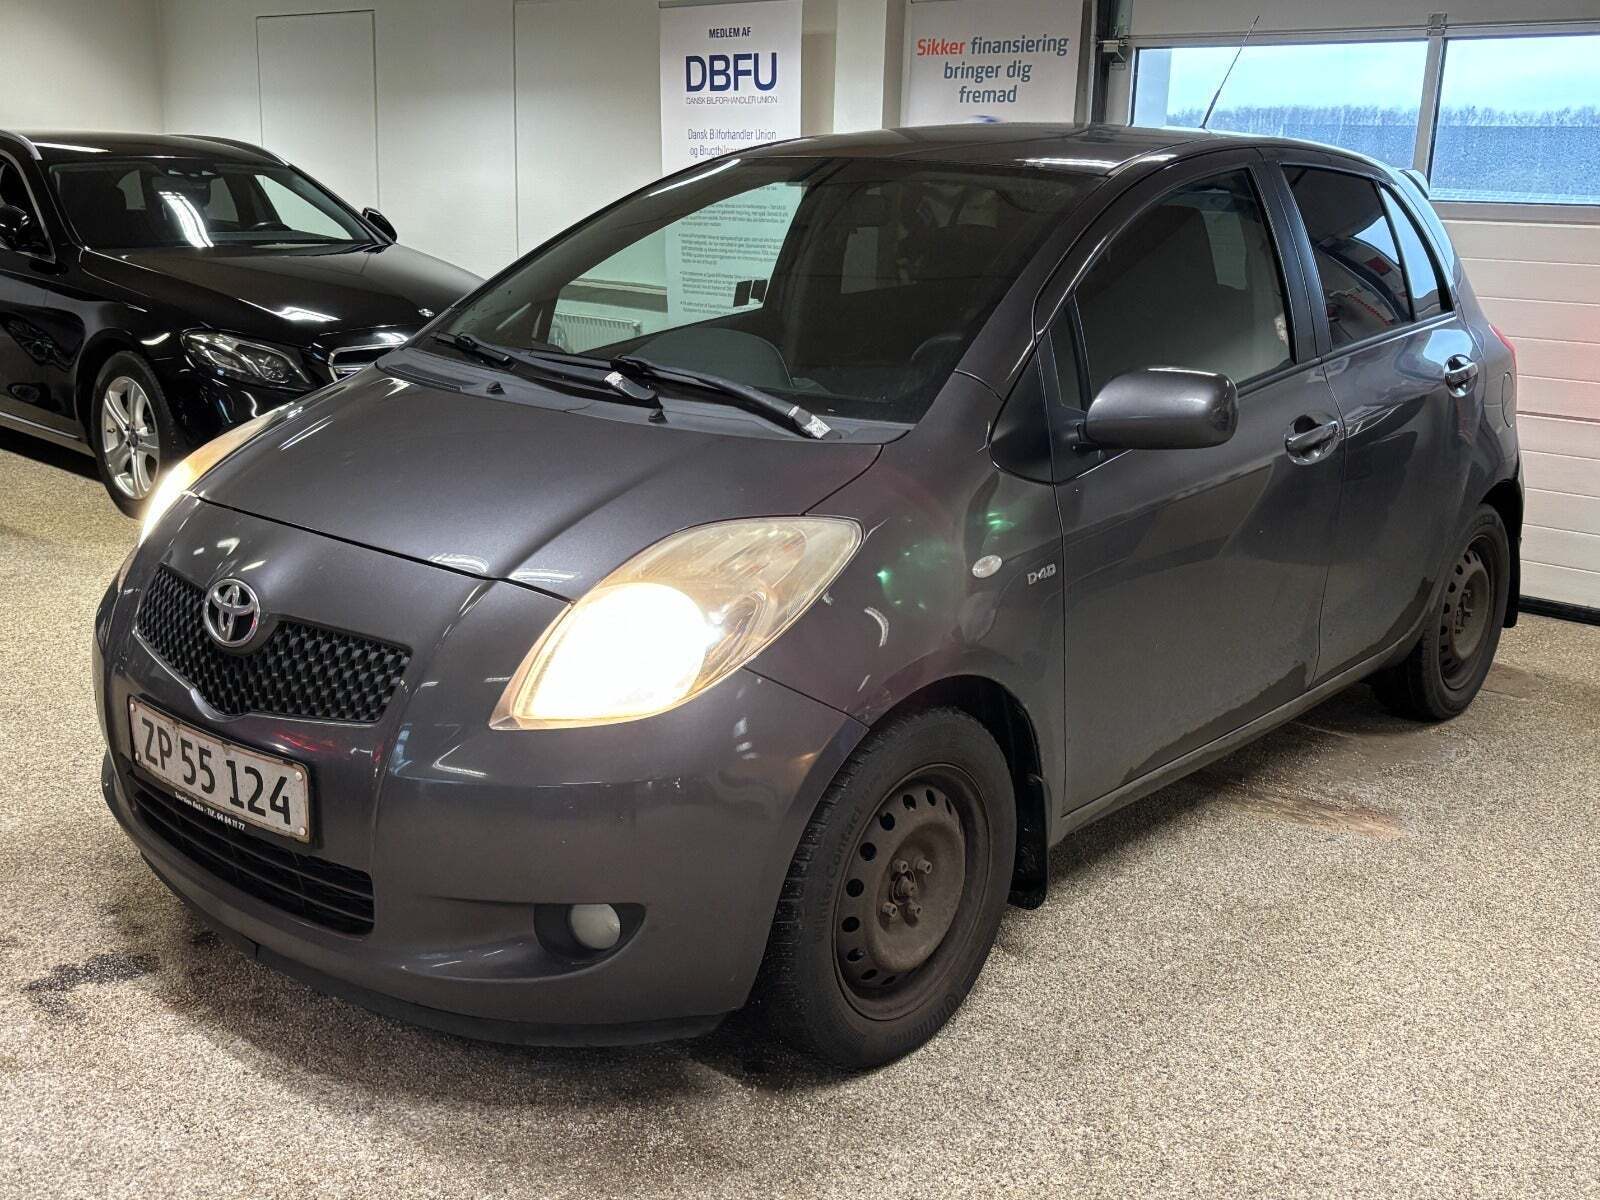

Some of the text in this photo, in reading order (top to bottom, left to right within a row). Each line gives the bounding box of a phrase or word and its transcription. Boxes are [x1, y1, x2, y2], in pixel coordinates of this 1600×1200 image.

[709, 26, 752, 39] MEDLEM AF
[917, 33, 1069, 57] Sikker finansiering
[685, 52, 777, 92] DBFU
[944, 60, 1032, 84] bringer dig
[686, 97, 706, 105] DANSK
[757, 95, 778, 104] UNION
[959, 85, 1017, 104] fremad
[688, 128, 777, 140] Dansk Bilforhandler Union
[689, 147, 699, 158] og
[142, 717, 292, 825] ZP 55 124
